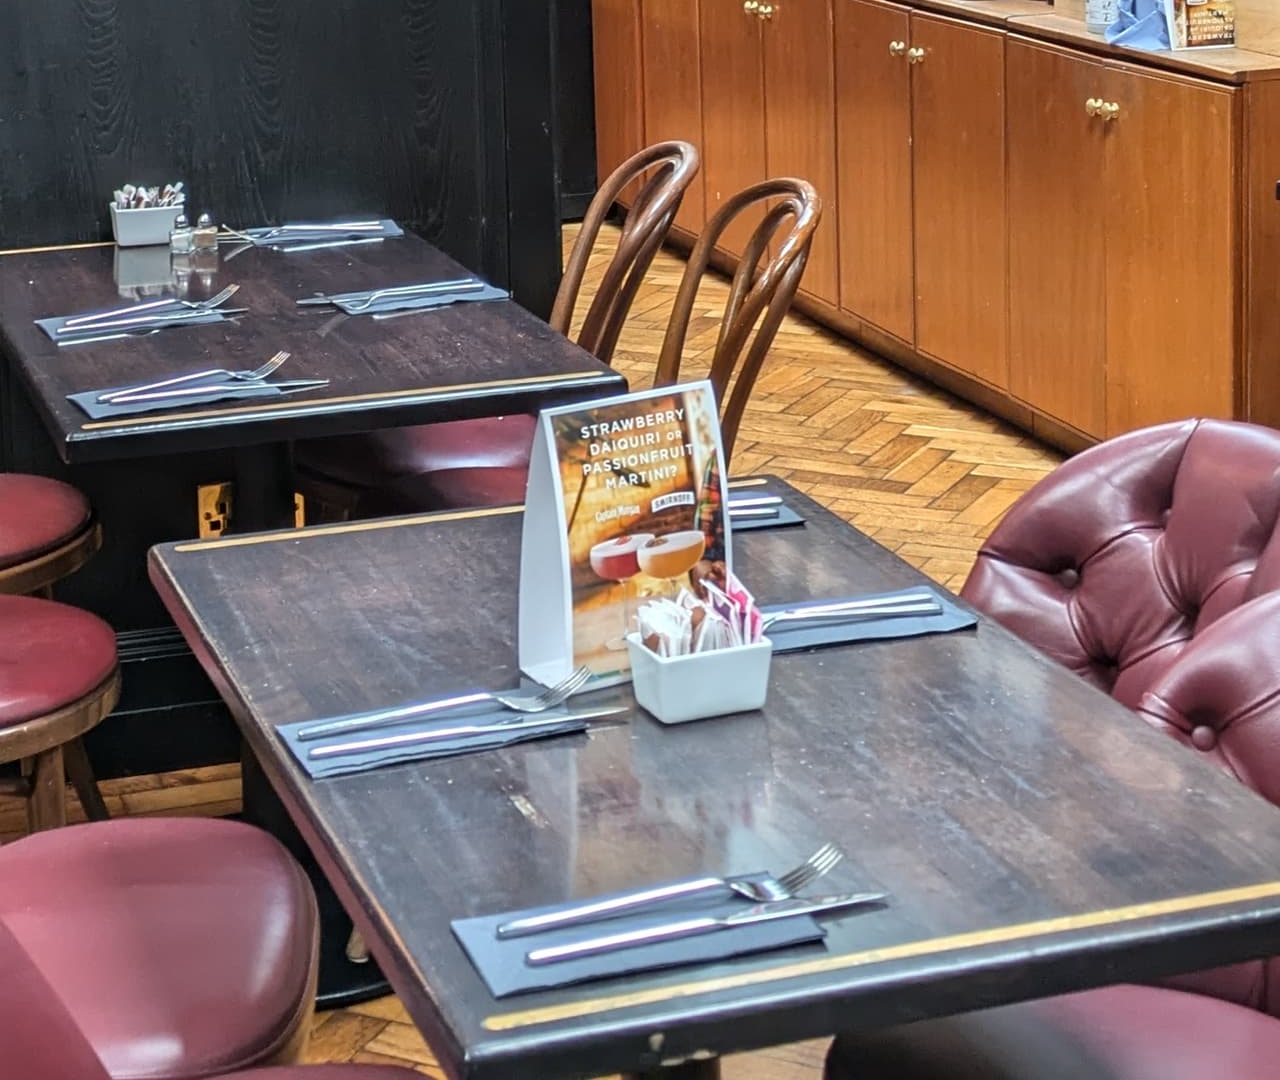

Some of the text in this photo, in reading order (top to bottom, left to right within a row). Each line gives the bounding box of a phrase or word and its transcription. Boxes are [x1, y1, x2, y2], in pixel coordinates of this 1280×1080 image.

[580, 408, 685, 439] STRAWBERRY
[589, 429, 683, 456] DAIQUIRI OR
[582, 443, 694, 476] PASSIONFRUIT
[604, 464, 678, 490] MARTINI?
[654, 493, 691, 509] SMIRNOFF
